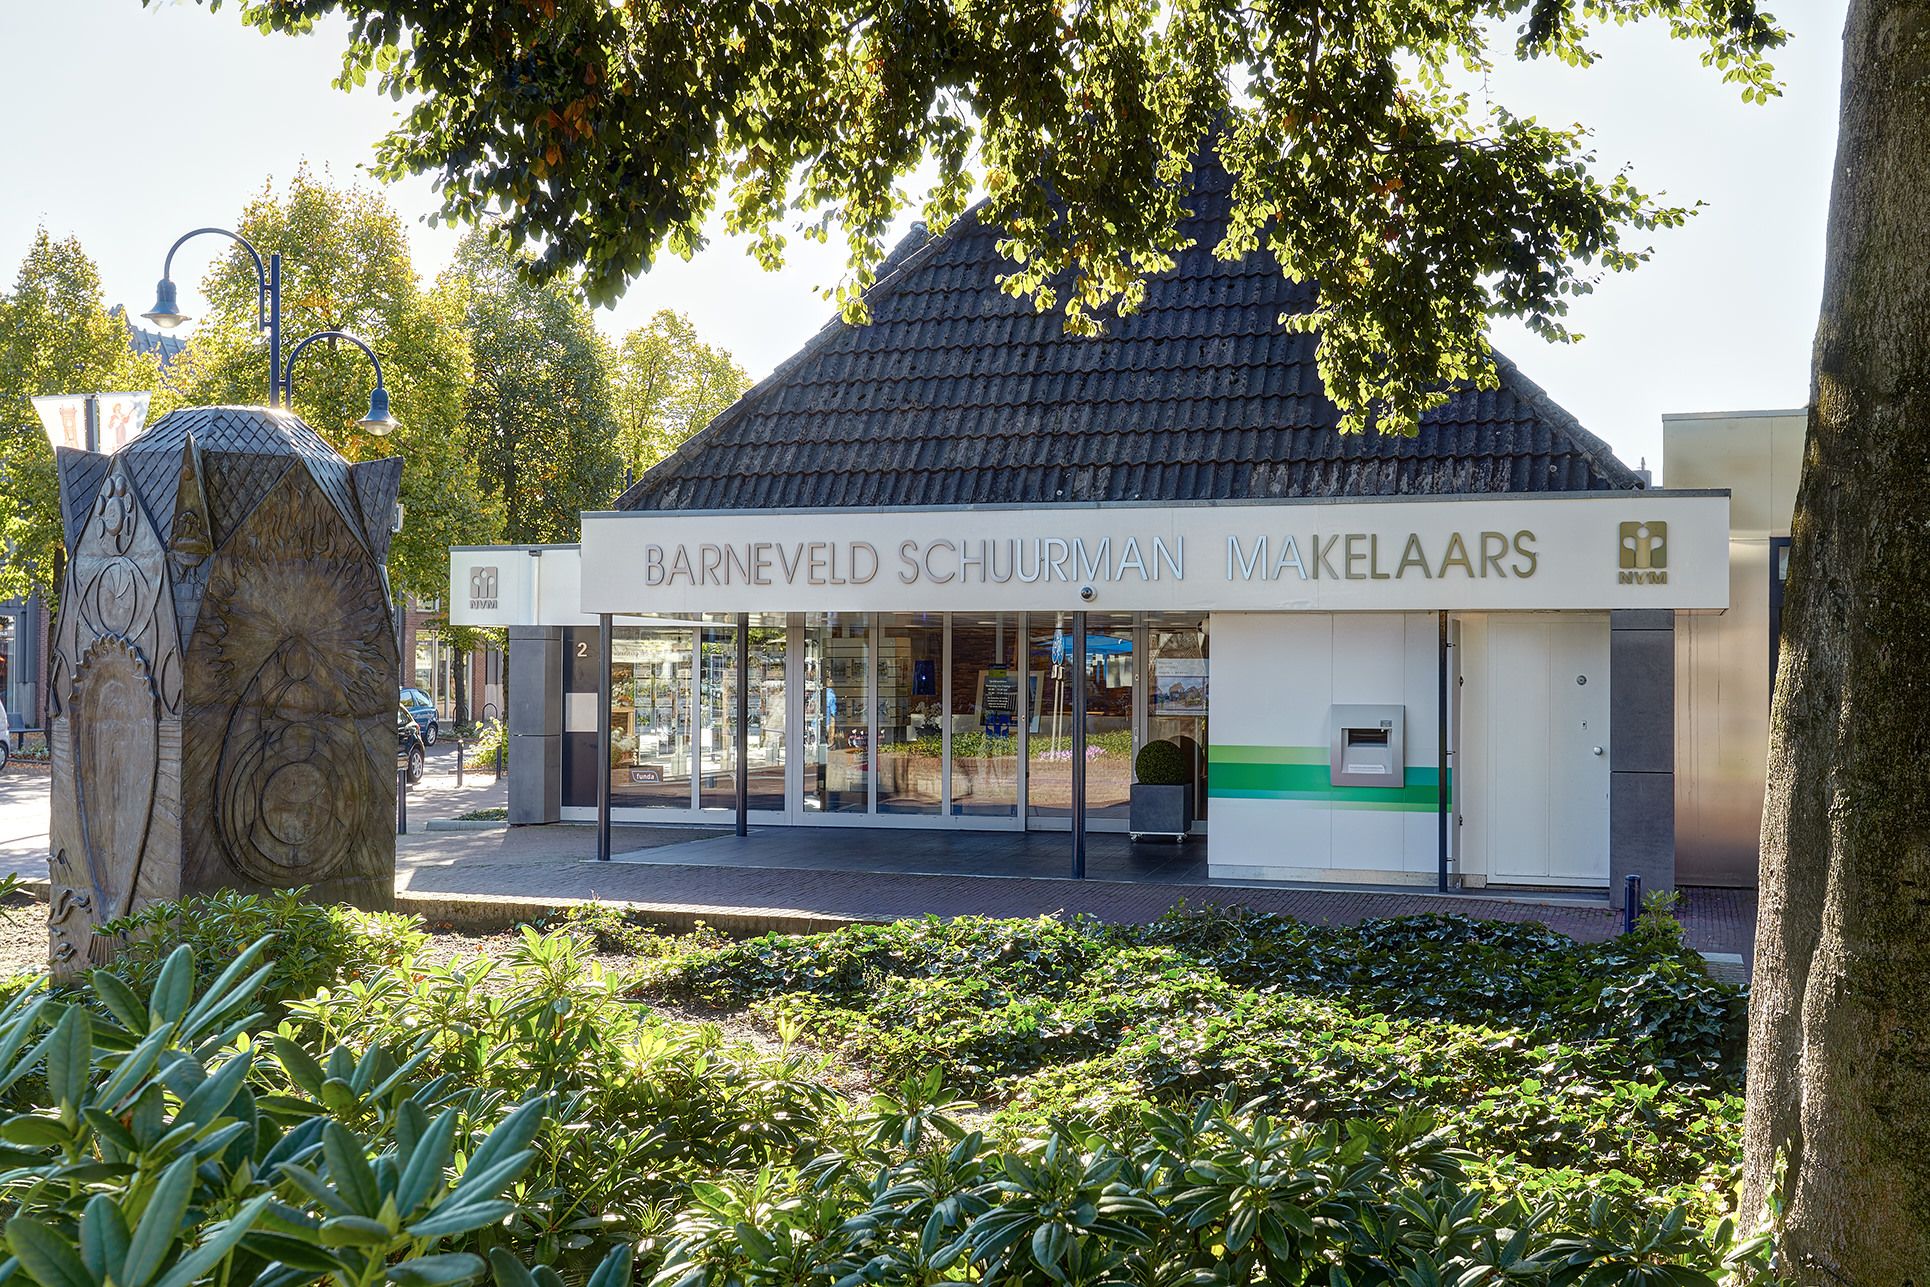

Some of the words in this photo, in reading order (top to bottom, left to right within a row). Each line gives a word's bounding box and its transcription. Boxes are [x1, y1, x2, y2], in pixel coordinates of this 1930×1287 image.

[645, 542, 879, 586] BARNEVELD
[898, 535, 1184, 584] SCHUURMAN
[1226, 529, 1537, 580] MAKELAARS
[1619, 571, 1667, 585] NVM
[470, 600, 498, 609] NVM
[577, 642, 588, 657] 2
